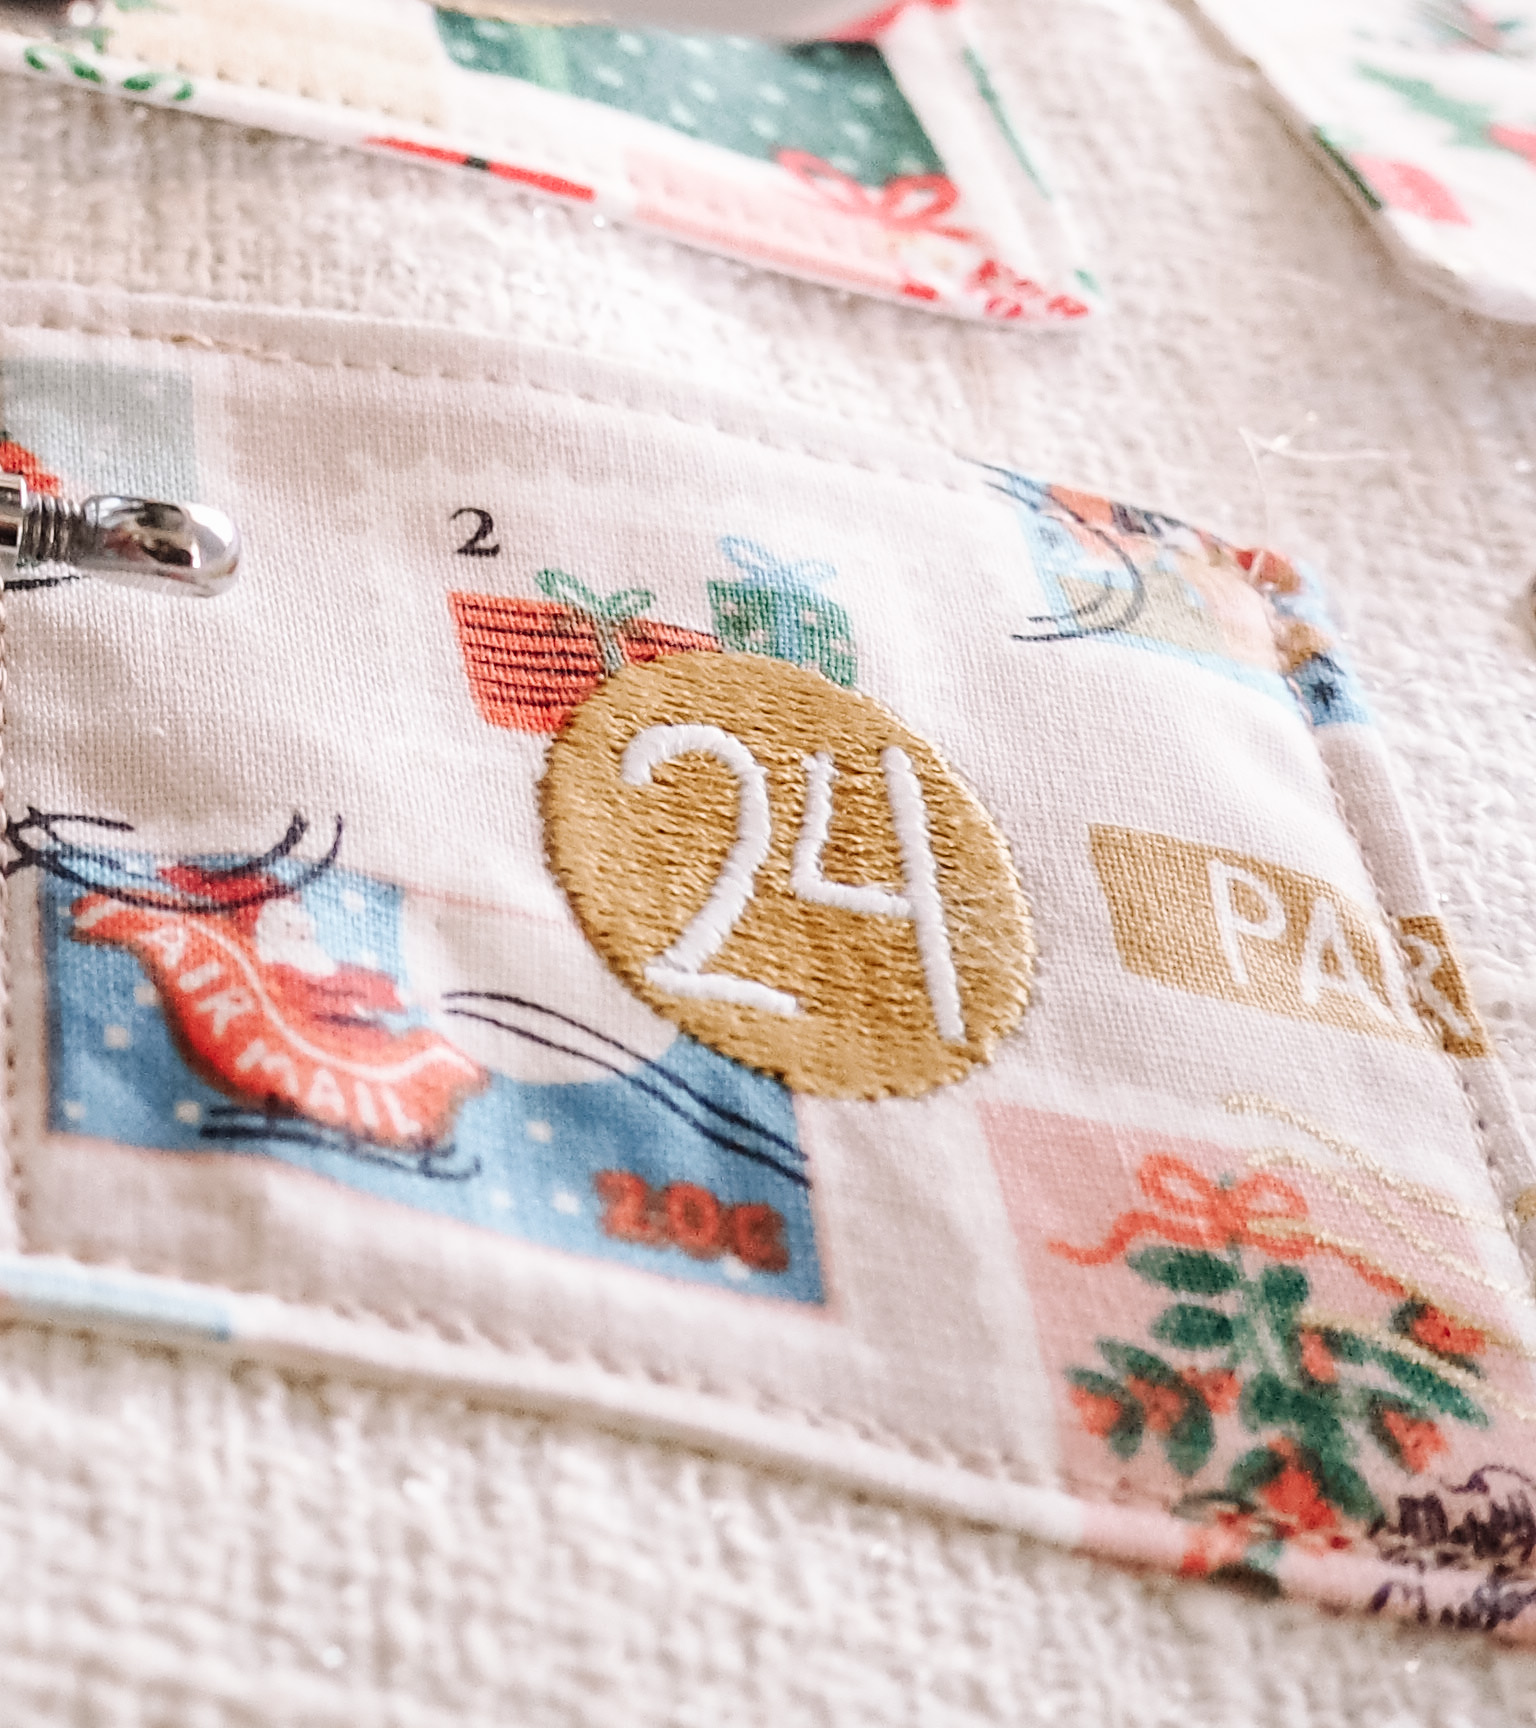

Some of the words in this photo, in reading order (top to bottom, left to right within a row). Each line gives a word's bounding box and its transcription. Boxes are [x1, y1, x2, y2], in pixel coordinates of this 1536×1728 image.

[449, 507, 501, 558] 2
[620, 723, 968, 1044] 24
[138, 925, 256, 1038] AIR
[234, 1039, 422, 1136] MAIL
